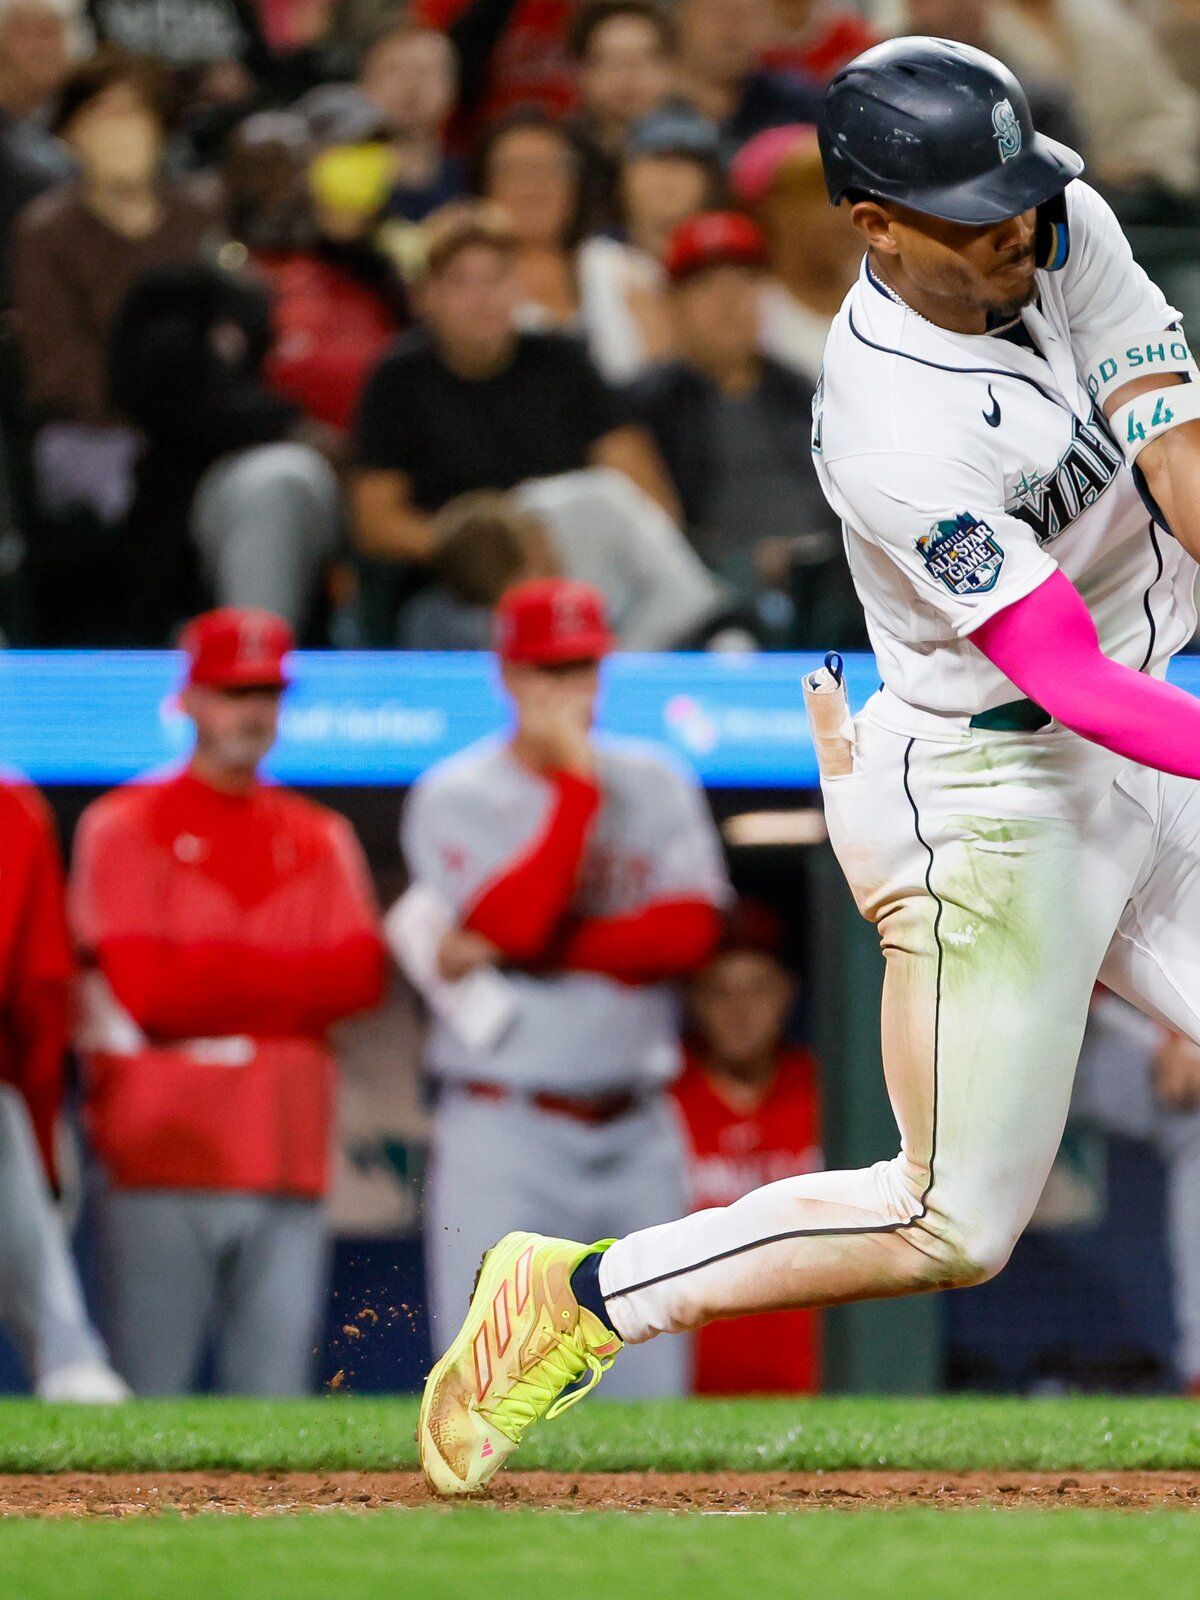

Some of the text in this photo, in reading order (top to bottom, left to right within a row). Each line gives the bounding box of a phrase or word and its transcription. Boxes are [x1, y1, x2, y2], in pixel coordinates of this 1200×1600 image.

[1127, 397, 1174, 444] 44
[936, 530, 965, 554] SEATTLE
[949, 545, 991, 580] GAME
